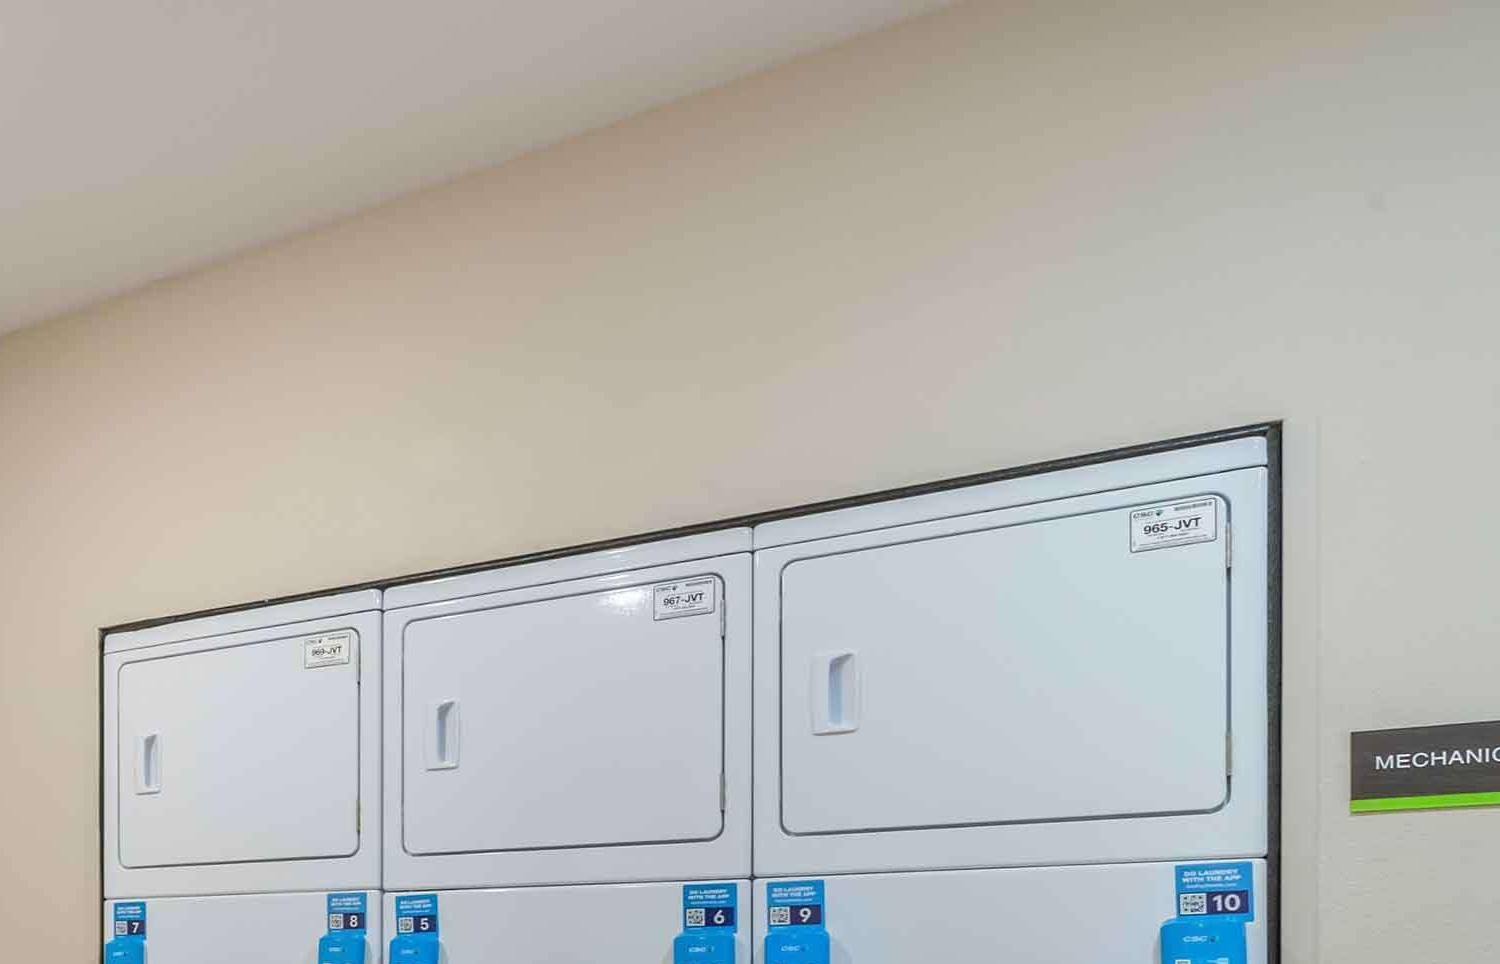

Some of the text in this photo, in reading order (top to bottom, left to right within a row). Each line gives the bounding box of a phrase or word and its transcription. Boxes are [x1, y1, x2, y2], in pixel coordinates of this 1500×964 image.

[1143, 517, 1202, 535] 965-JVT
[1212, 893, 1241, 912] 10
[349, 915, 359, 928] 8
[713, 909, 725, 924] 6
[799, 907, 812, 923] 9
[131, 921, 140, 934] 7
[420, 918, 430, 931] 5
